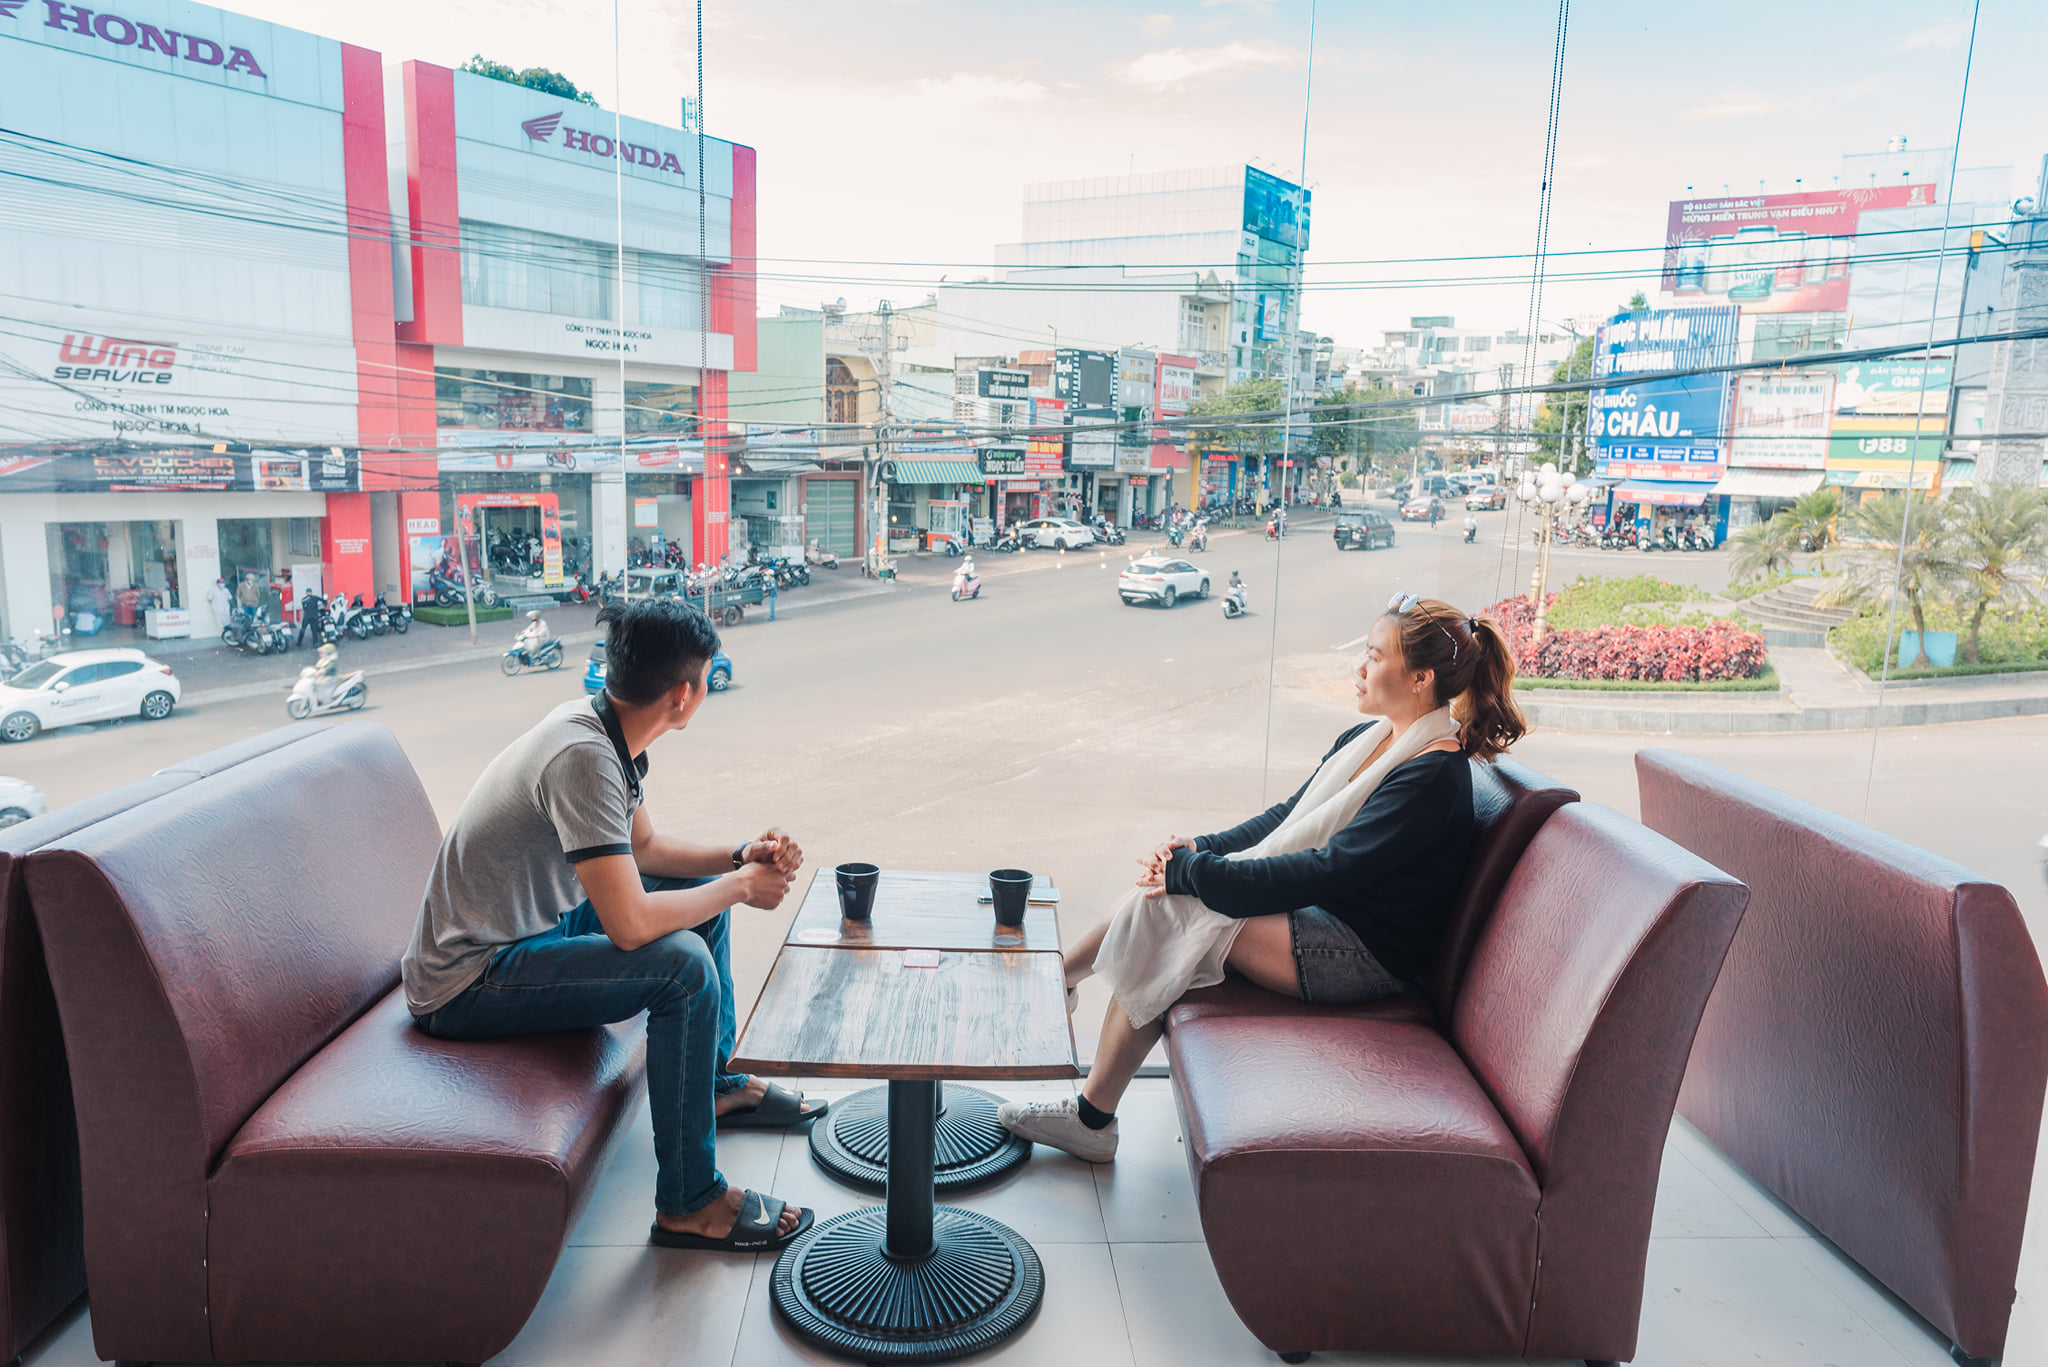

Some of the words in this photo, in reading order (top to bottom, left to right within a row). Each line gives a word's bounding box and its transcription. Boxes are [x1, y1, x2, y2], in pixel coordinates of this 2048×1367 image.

[42, 0, 267, 78] HONDA
[563, 126, 685, 175] HONDA
[1703, 201, 1718, 210] LON
[1682, 210, 1709, 223] MỪNG
[1712, 209, 1736, 222] MIỀN
[1737, 209, 1768, 221] TRUNG
[1770, 208, 1789, 220] VẠN
[565, 323, 584, 333] CÔNG
[586, 326, 594, 334] TY
[59, 335, 179, 369] WING
[585, 339, 610, 351] NGỌC
[53, 366, 173, 384] SERVICE
[75, 400, 107, 412] CÔNG
[111, 402, 125, 412] TY
[130, 402, 157, 414] TNHH
[160, 404, 174, 414] TM
[177, 405, 206, 417] NGỌC
[208, 407, 229, 416] HOA
[113, 420, 155, 435] NGỌC
[1607, 404, 1680, 437] CHÂU
[1858, 438, 1908, 454] F88
[93, 456, 235, 468] E-VOUCHER
[409, 520, 437, 529] HEAD
